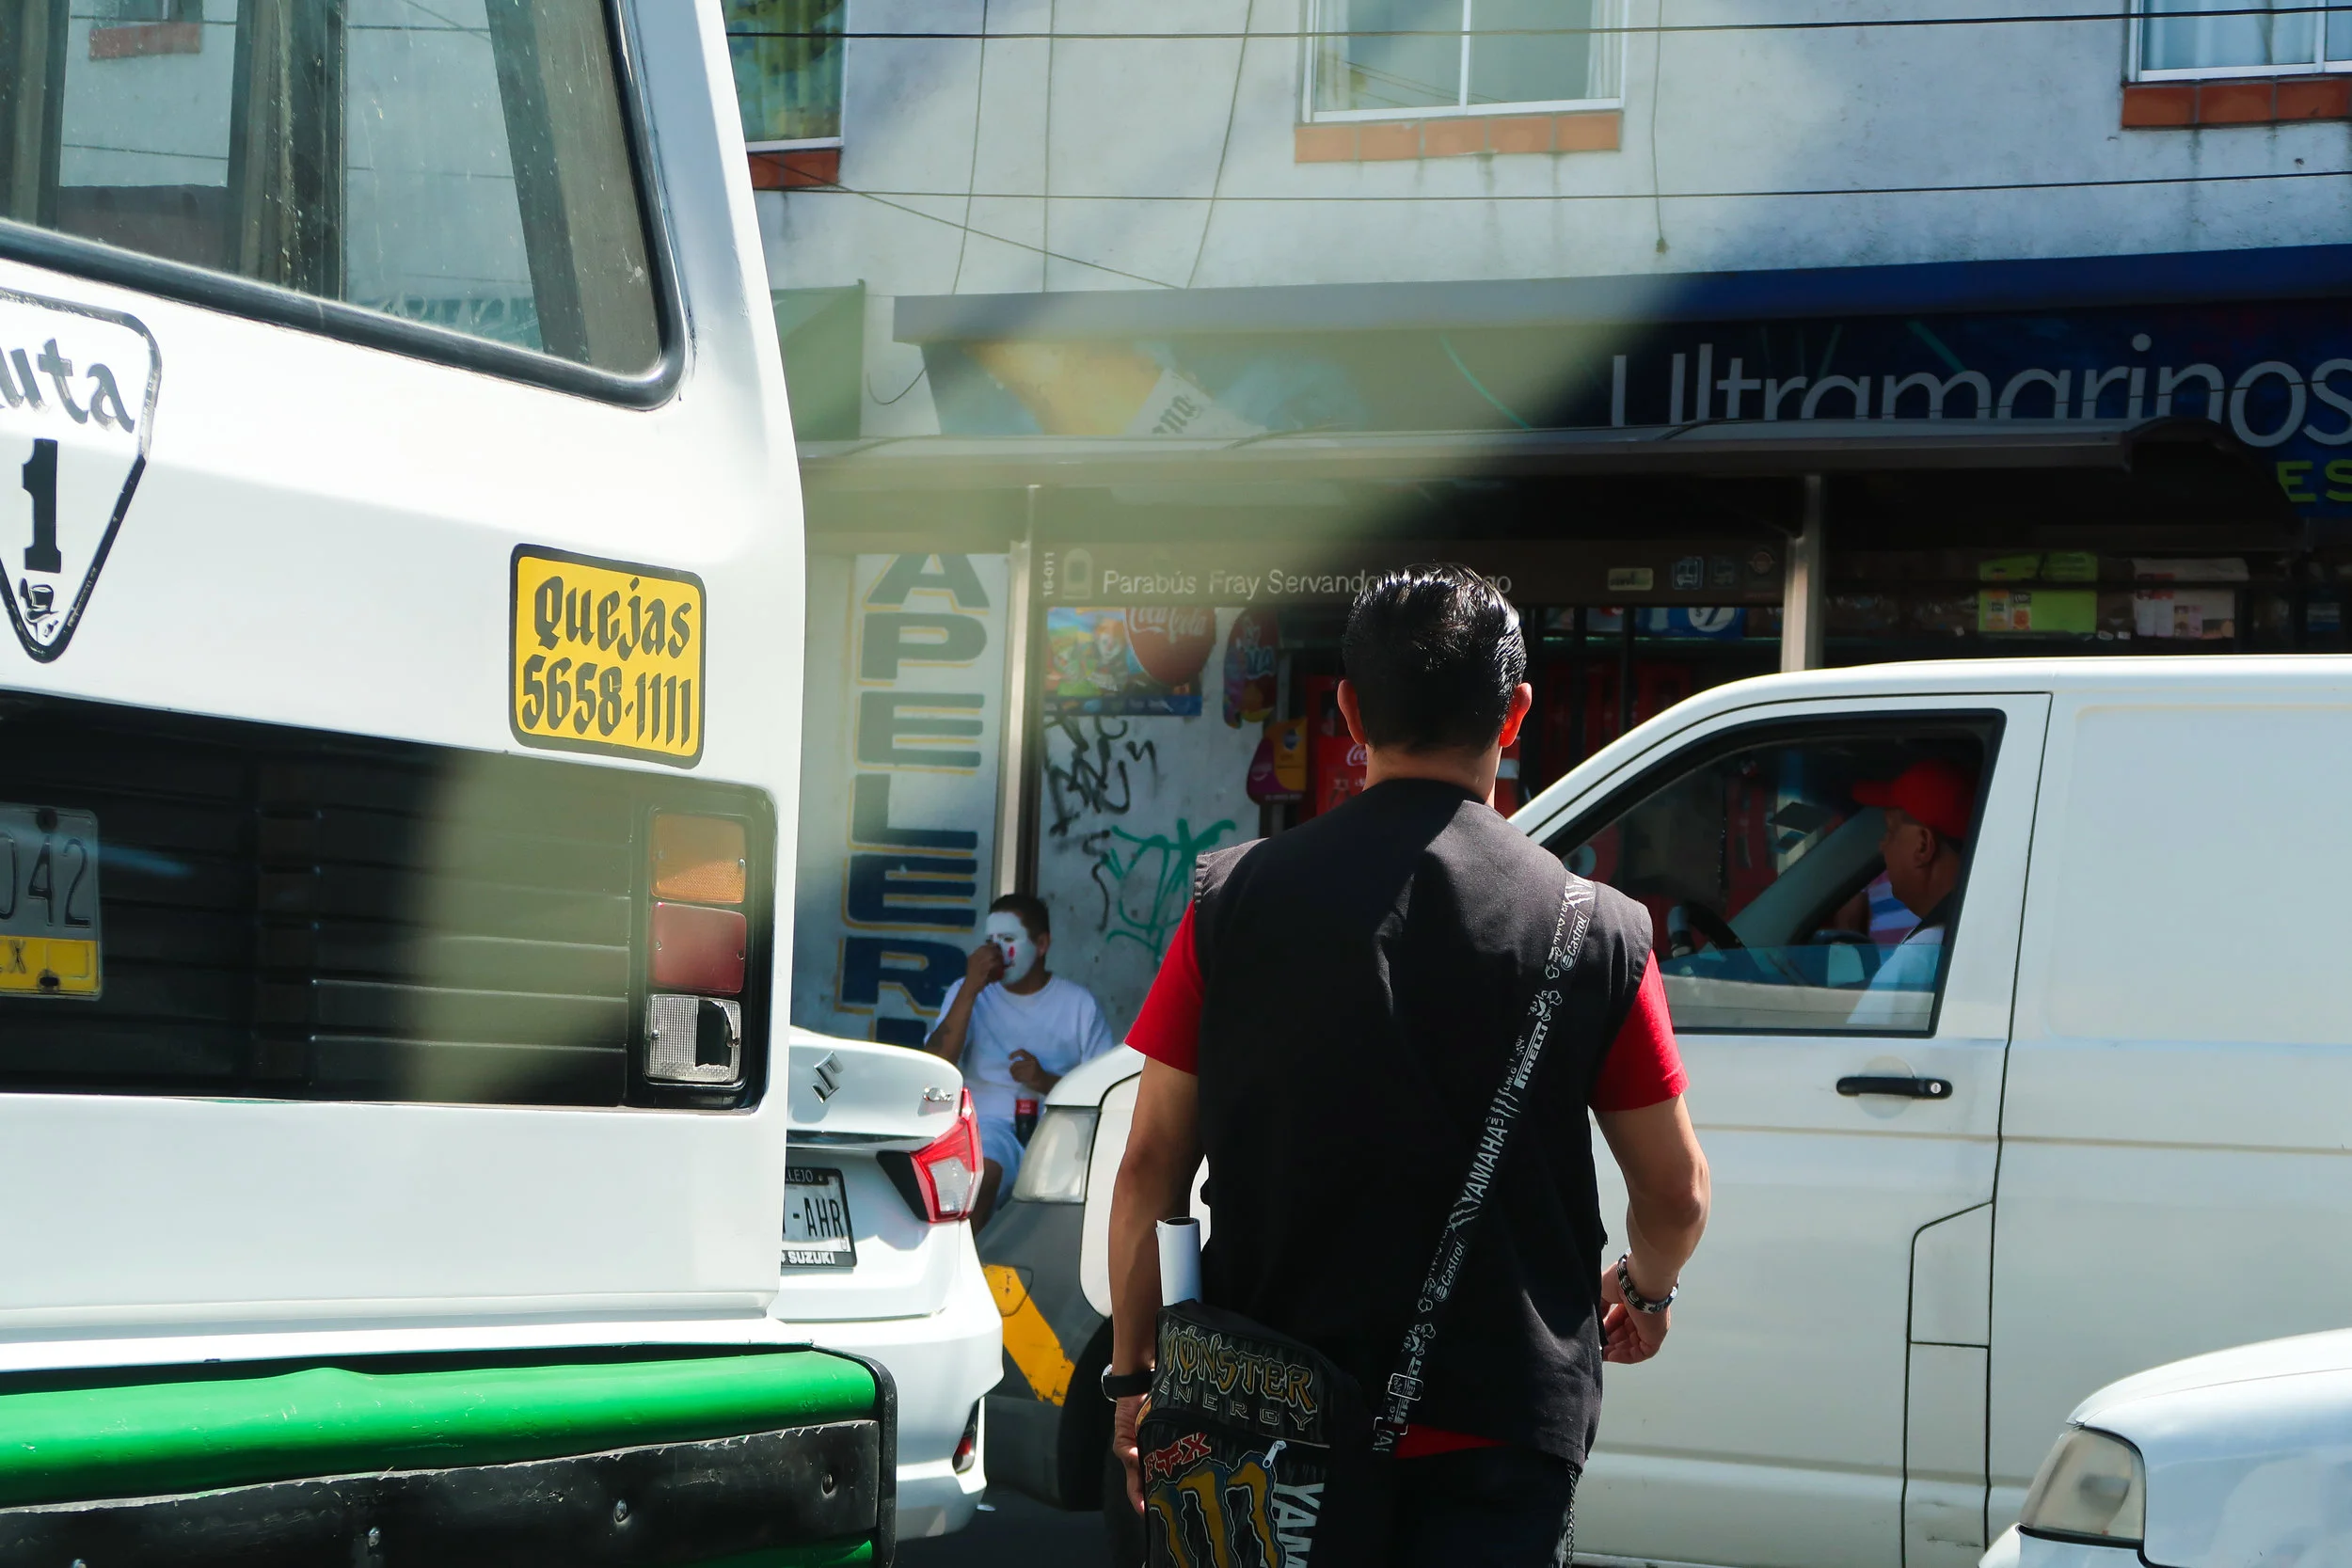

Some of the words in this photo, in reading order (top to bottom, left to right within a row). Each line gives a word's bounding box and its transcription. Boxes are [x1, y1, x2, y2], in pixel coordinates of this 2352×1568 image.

[22, 438, 61, 574] 1
[1104, 569, 1197, 594] Parabús
[1209, 570, 1262, 600] Fray
[534, 576, 692, 661] Quejas
[1566, 915, 1588, 958] Castrol
[1513, 1021, 1549, 1090] PIRELLI
[1461, 1126, 1508, 1204] YAMAHA
[783, 1197, 844, 1238] -AHR
[787, 1251, 835, 1265] SUZUKI
[1440, 1240, 1466, 1287] Castrol
[1161, 1323, 1318, 1414] MONSTER
[1158, 1375, 1314, 1431] ENERGY
